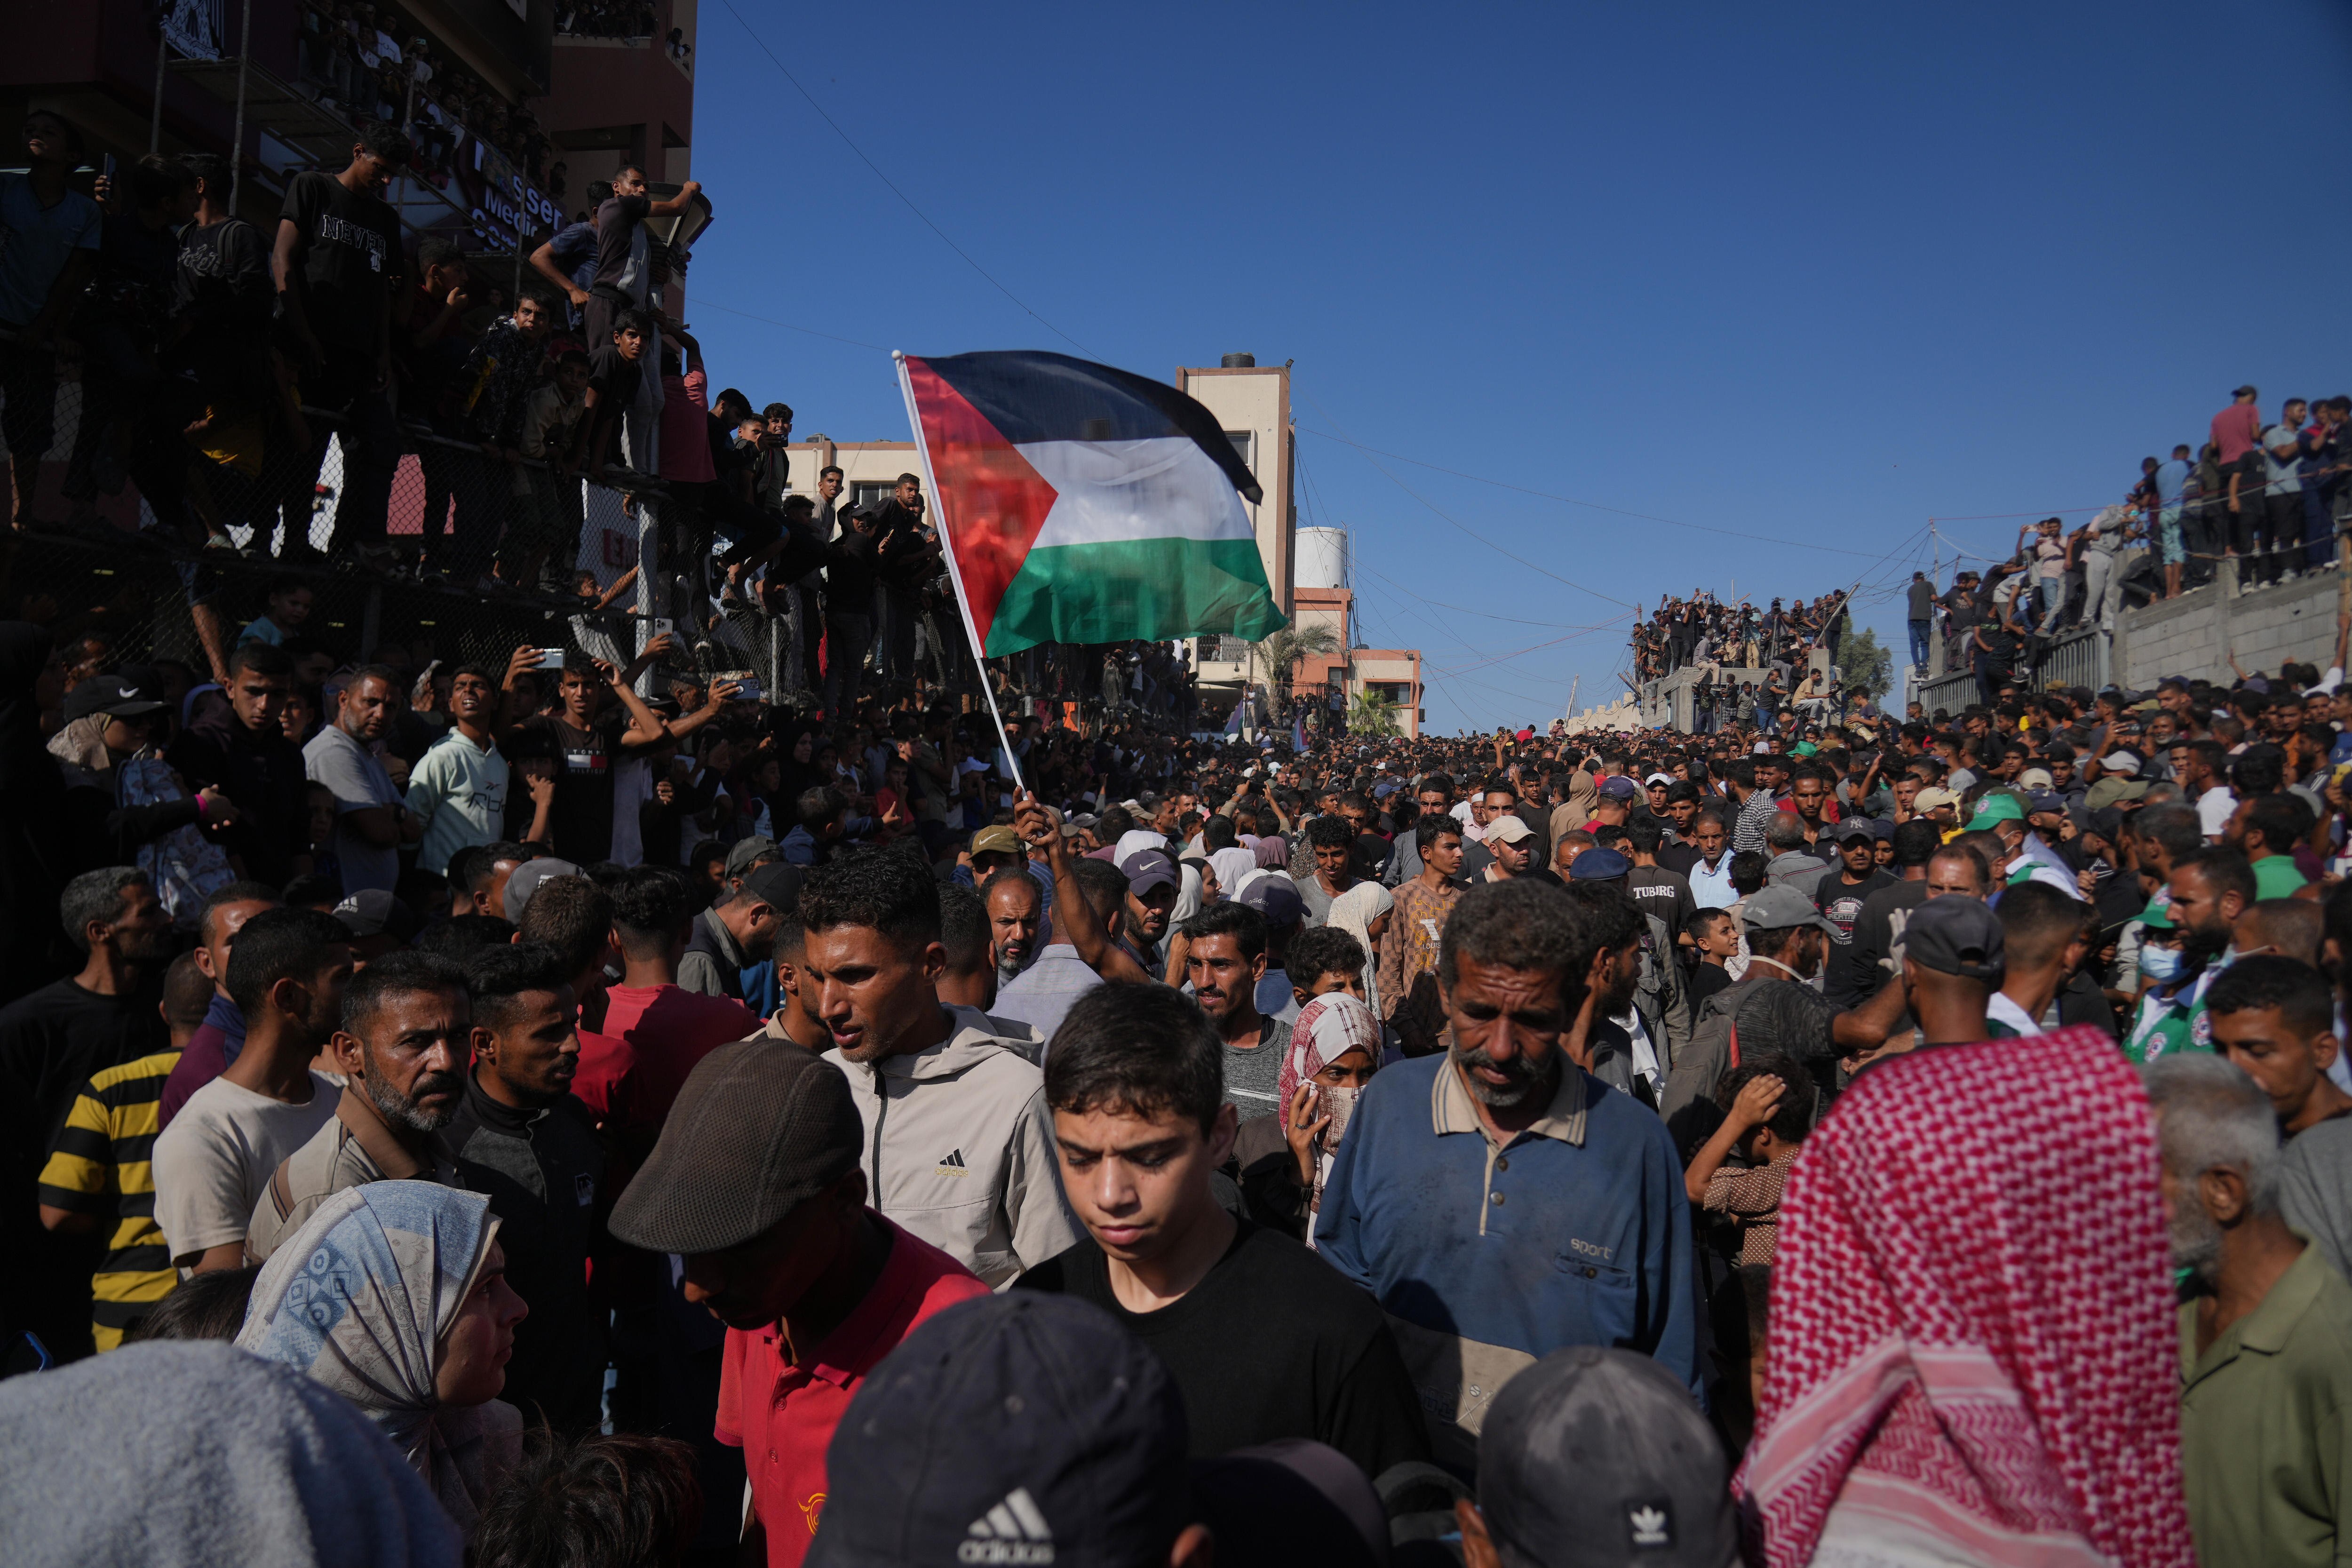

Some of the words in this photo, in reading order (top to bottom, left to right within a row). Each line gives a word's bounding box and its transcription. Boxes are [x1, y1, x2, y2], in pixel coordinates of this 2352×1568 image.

[322, 215, 387, 260] NEVER
[1850, 819, 1863, 828] NY
[1633, 885, 1675, 899] TUBORG
[1248, 897, 1269, 907] adidas
[935, 1166, 968, 1178] adidas
[1571, 1238, 1613, 1260] sport
[957, 1538, 1055, 1566] adidas
